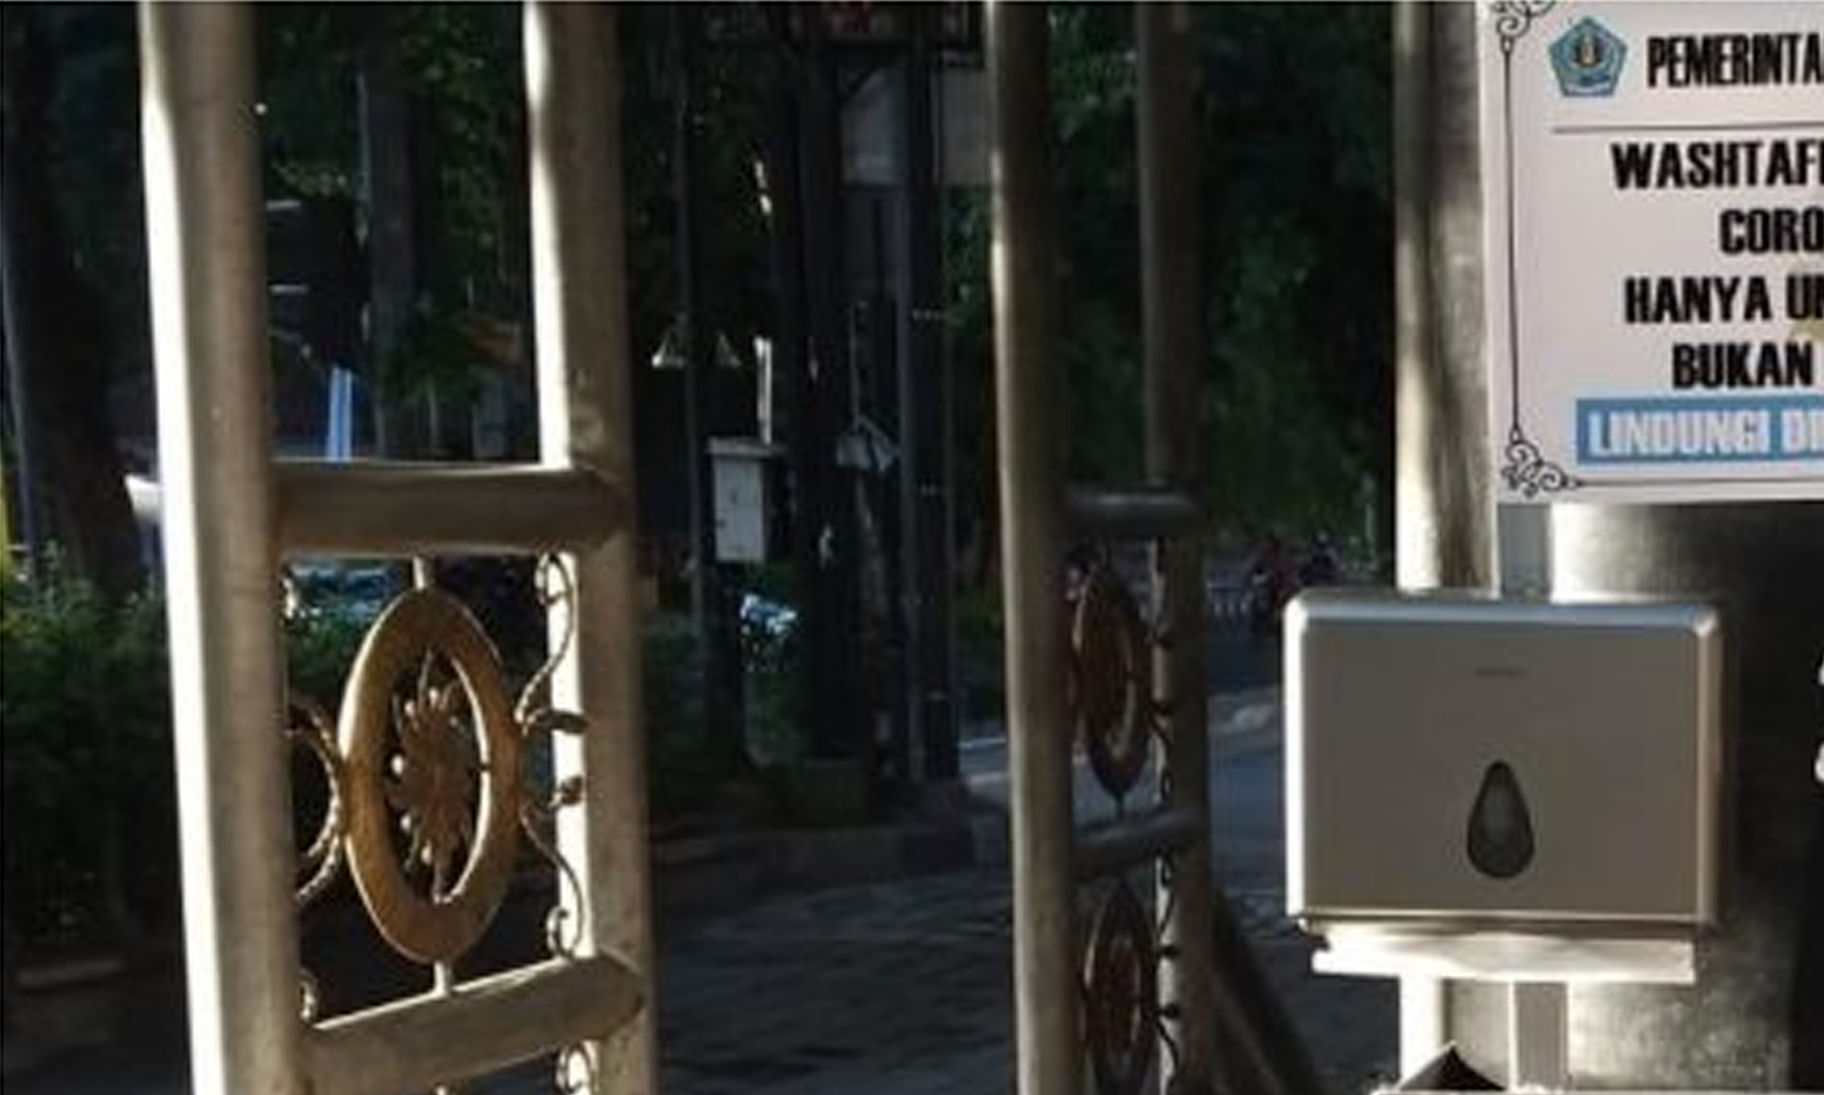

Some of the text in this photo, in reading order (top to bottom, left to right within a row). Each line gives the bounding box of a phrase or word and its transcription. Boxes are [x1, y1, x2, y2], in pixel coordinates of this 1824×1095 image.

[1624, 275, 1773, 324] HANYA
[1672, 341, 1814, 390] BUKAN
[1587, 409, 1771, 456] LINDUNGI
